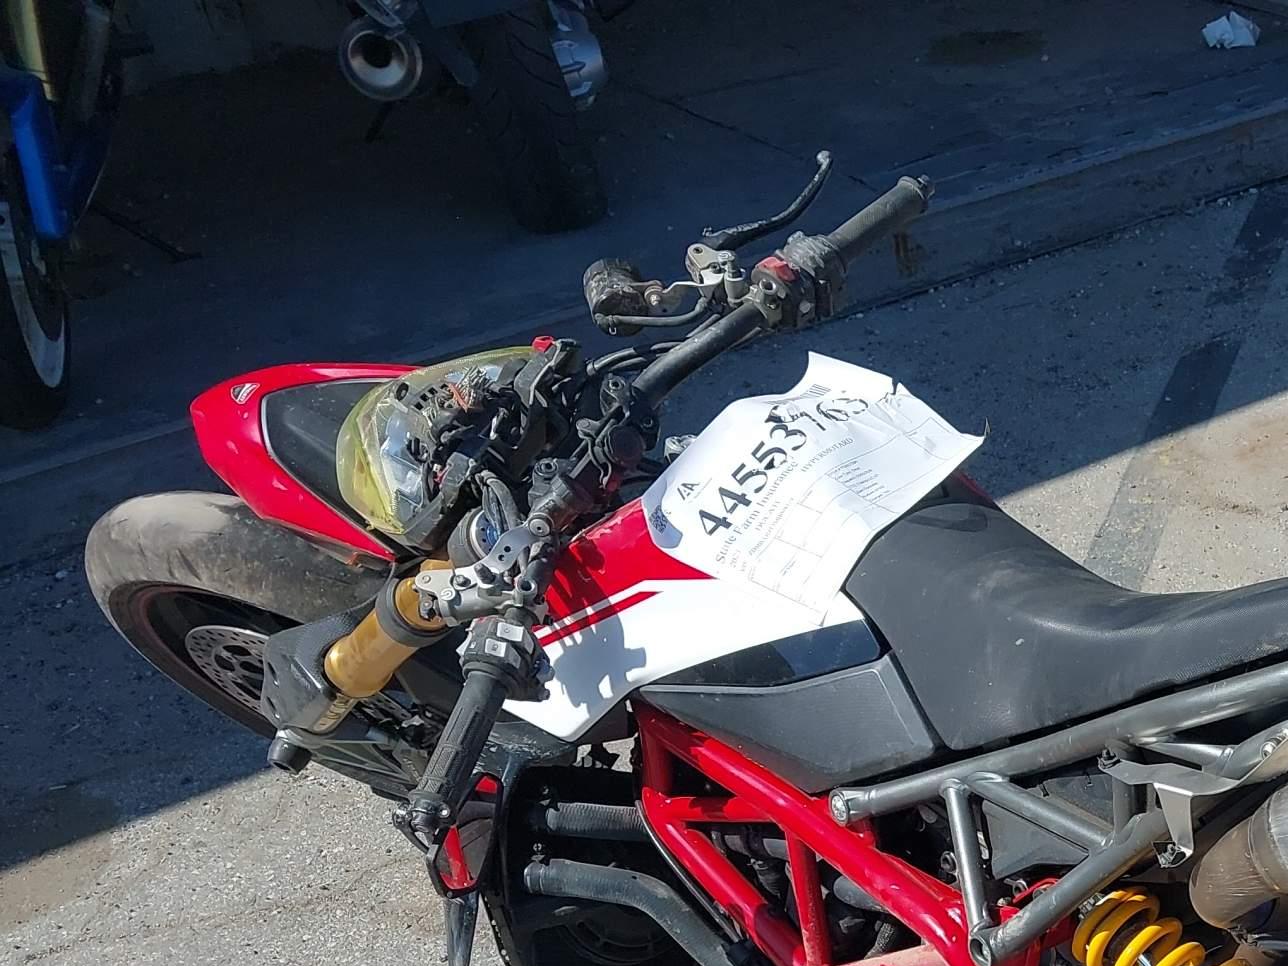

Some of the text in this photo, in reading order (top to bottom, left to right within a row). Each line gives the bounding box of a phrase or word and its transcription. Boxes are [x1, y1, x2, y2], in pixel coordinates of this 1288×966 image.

[800, 437, 855, 473] HYPERMOTARD
[715, 530, 738, 563] State
[733, 507, 760, 535] Farm
[757, 461, 799, 512] Insurance
